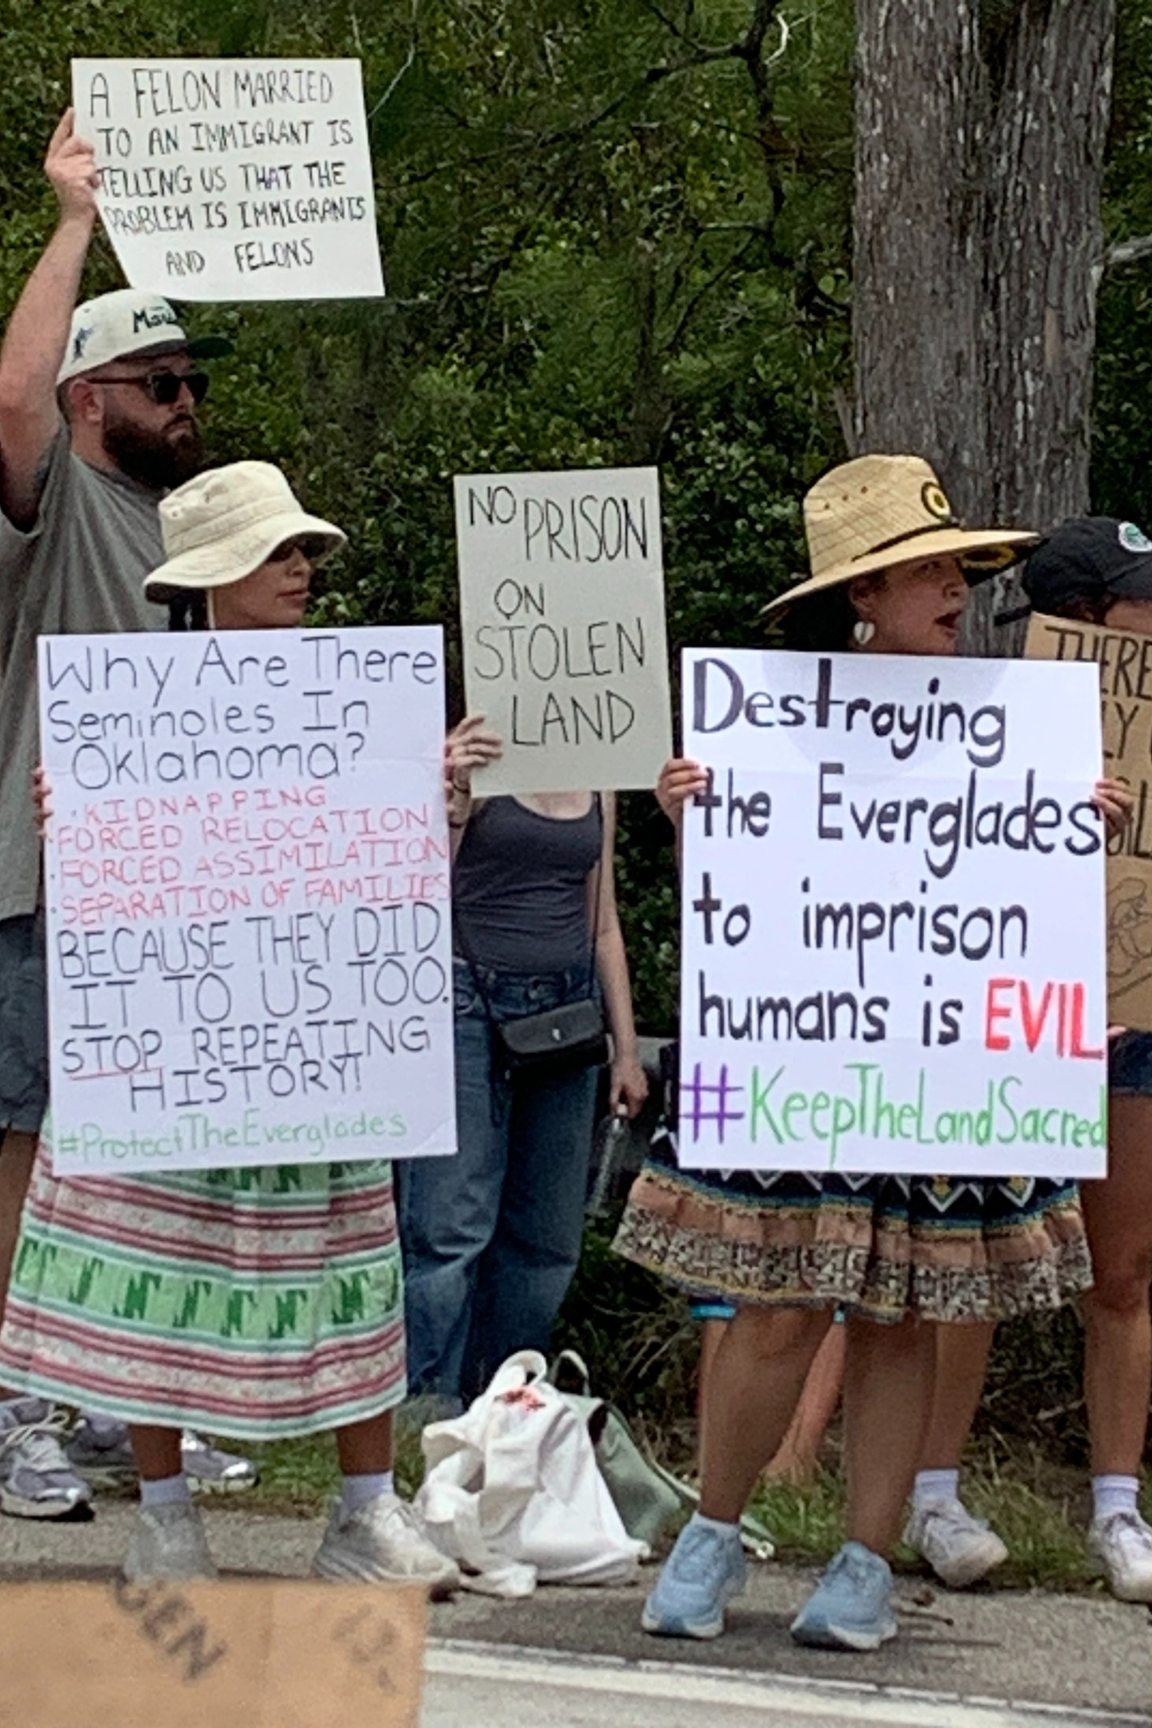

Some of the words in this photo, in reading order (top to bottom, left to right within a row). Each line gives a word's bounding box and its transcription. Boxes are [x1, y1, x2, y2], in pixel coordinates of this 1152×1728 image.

[90, 72, 110, 118] A
[132, 68, 221, 118] FELON
[234, 69, 332, 108] MARRIED
[97, 127, 131, 157] TO
[149, 124, 179, 156] AN
[190, 118, 314, 152] IMMIGRANT
[327, 120, 353, 146] IS
[97, 167, 193, 198] TELLING
[201, 166, 227, 193] US
[240, 163, 293, 193] THAT
[304, 161, 347, 187] THE
[104, 202, 195, 236] PROBLEM
[204, 202, 227, 229] IS
[238, 195, 366, 229] IMMIGRANTS
[165, 250, 205, 276] AND
[234, 238, 314, 273] FELONS
[468, 485, 516, 525] NO
[524, 495, 648, 562] PRISON
[494, 578, 545, 620] ON
[44, 640, 176, 707] Why
[193, 638, 290, 688] Are
[300, 635, 438, 685] There
[475, 617, 645, 681] STOLEN
[46, 698, 276, 744] Seminoles
[301, 691, 369, 730] In
[512, 689, 635, 746] LAND
[693, 658, 1006, 768] Destroying
[71, 733, 366, 789] Oklahoma?
[57, 824, 182, 853] FORCED
[201, 804, 430, 843] RELOCATION
[84, 785, 327, 825] KIDNAPPING
[692, 767, 771, 838] the
[817, 762, 1101, 878] Everglades
[60, 856, 182, 888] FORCED
[196, 836, 449, 880] ASSIMILATION
[61, 885, 251, 926] SEPARATION
[262, 879, 295, 908] OF
[304, 872, 449, 905] FAMILIES
[57, 921, 234, 979] BECAUSE
[245, 912, 336, 965] THEY
[353, 903, 441, 958] DID
[693, 873, 751, 947] to
[801, 877, 1028, 987] imprison
[69, 981, 136, 1030] IT
[162, 973, 232, 1024] TO
[261, 966, 332, 1017] US
[347, 956, 450, 1006] TOO.
[699, 970, 889, 1043] humans
[922, 974, 963, 1046] is
[985, 978, 1104, 1059] EVIL
[62, 1029, 162, 1074] STOP
[193, 1016, 430, 1066] REPEATING
[130, 1057, 364, 1111] HISTORY!
[58, 1108, 407, 1161] #ProtectTheEverglades
[679, 1062, 1107, 1169] #KeepTheLandSacred
